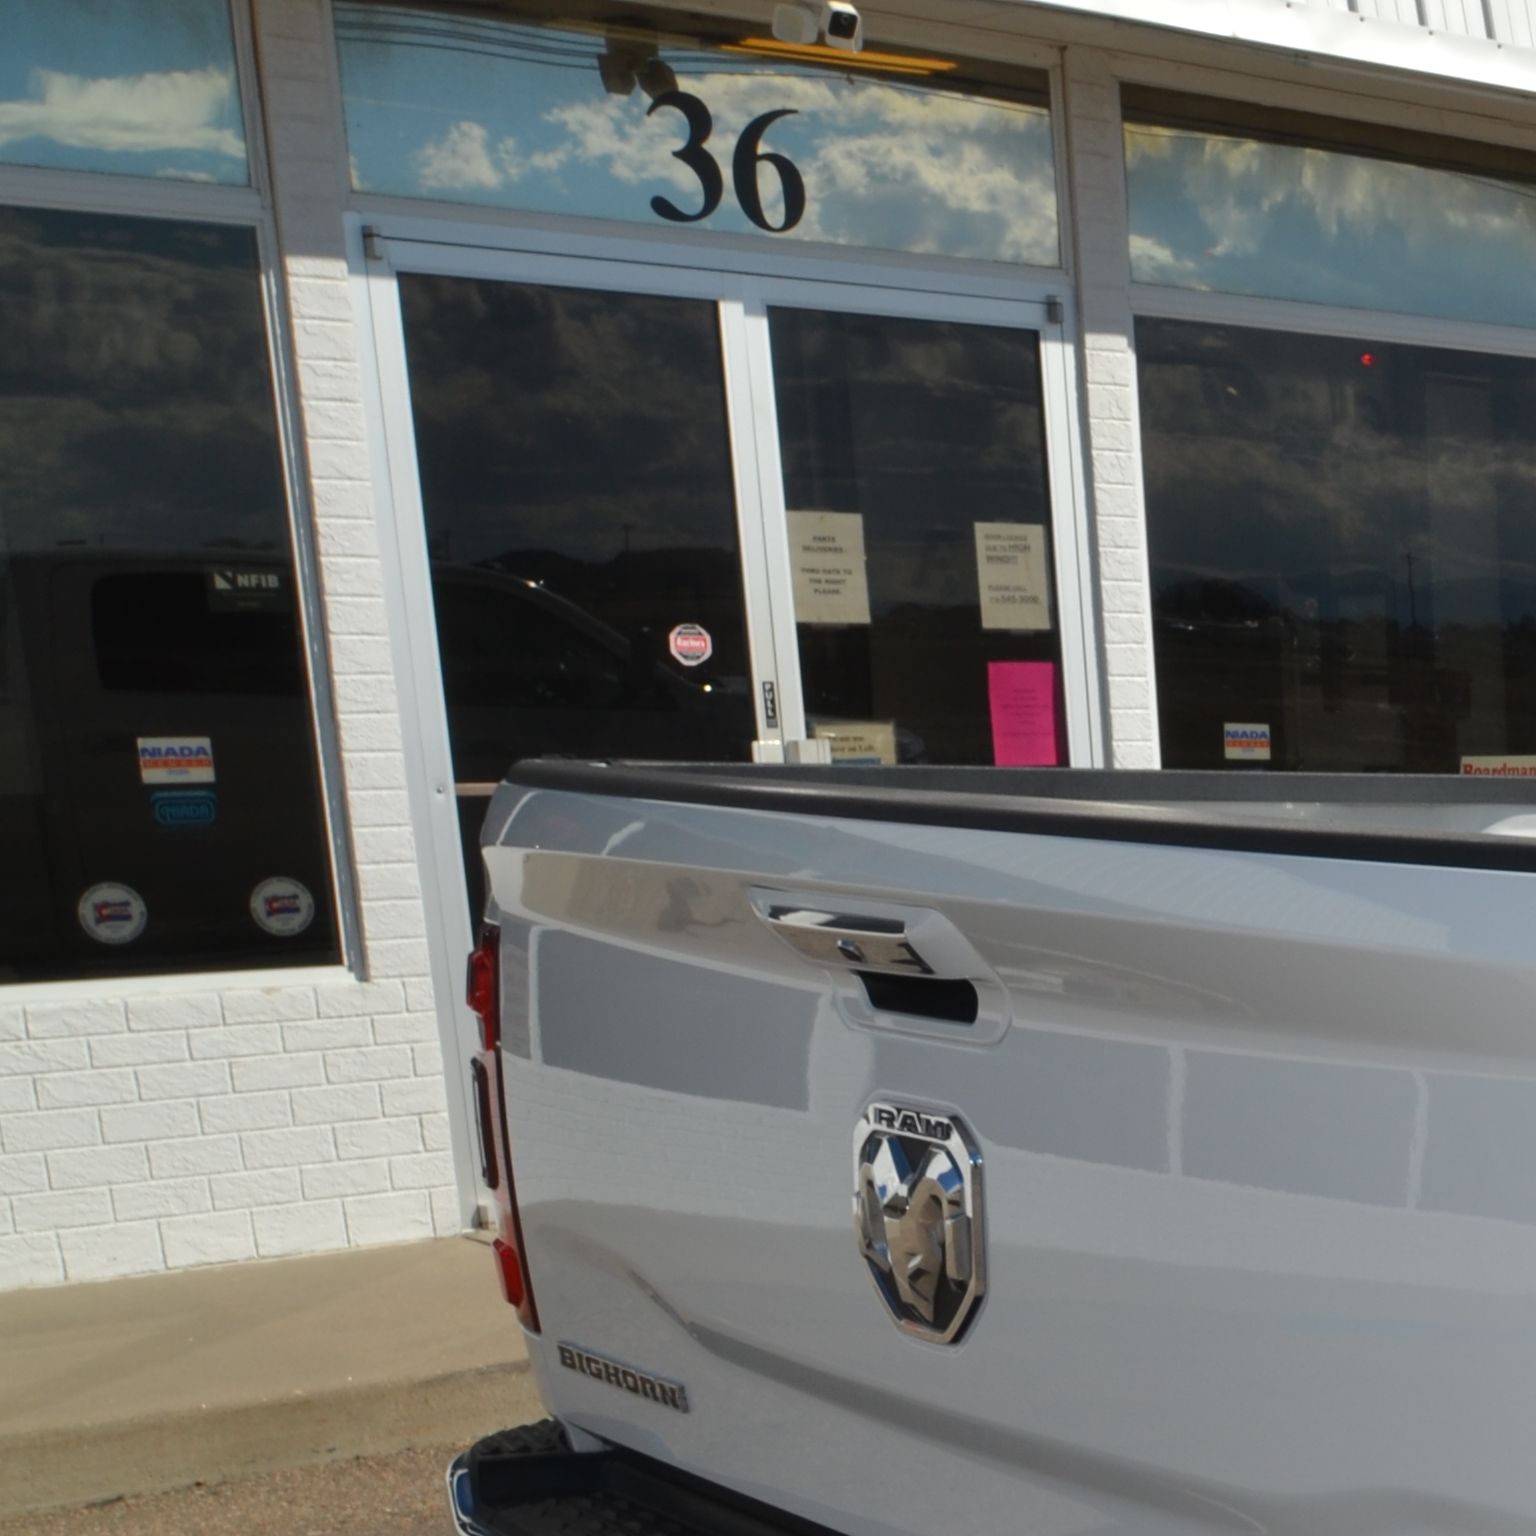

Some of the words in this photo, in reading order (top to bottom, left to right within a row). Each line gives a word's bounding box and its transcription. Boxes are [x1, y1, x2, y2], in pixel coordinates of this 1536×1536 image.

[646, 91, 806, 233] 36
[236, 573, 279, 588] NFIB
[1225, 730, 1268, 740] NIADA
[141, 745, 209, 758] NIADA
[872, 1106, 953, 1141] RAM
[557, 1342, 684, 1411] BIGHORN
